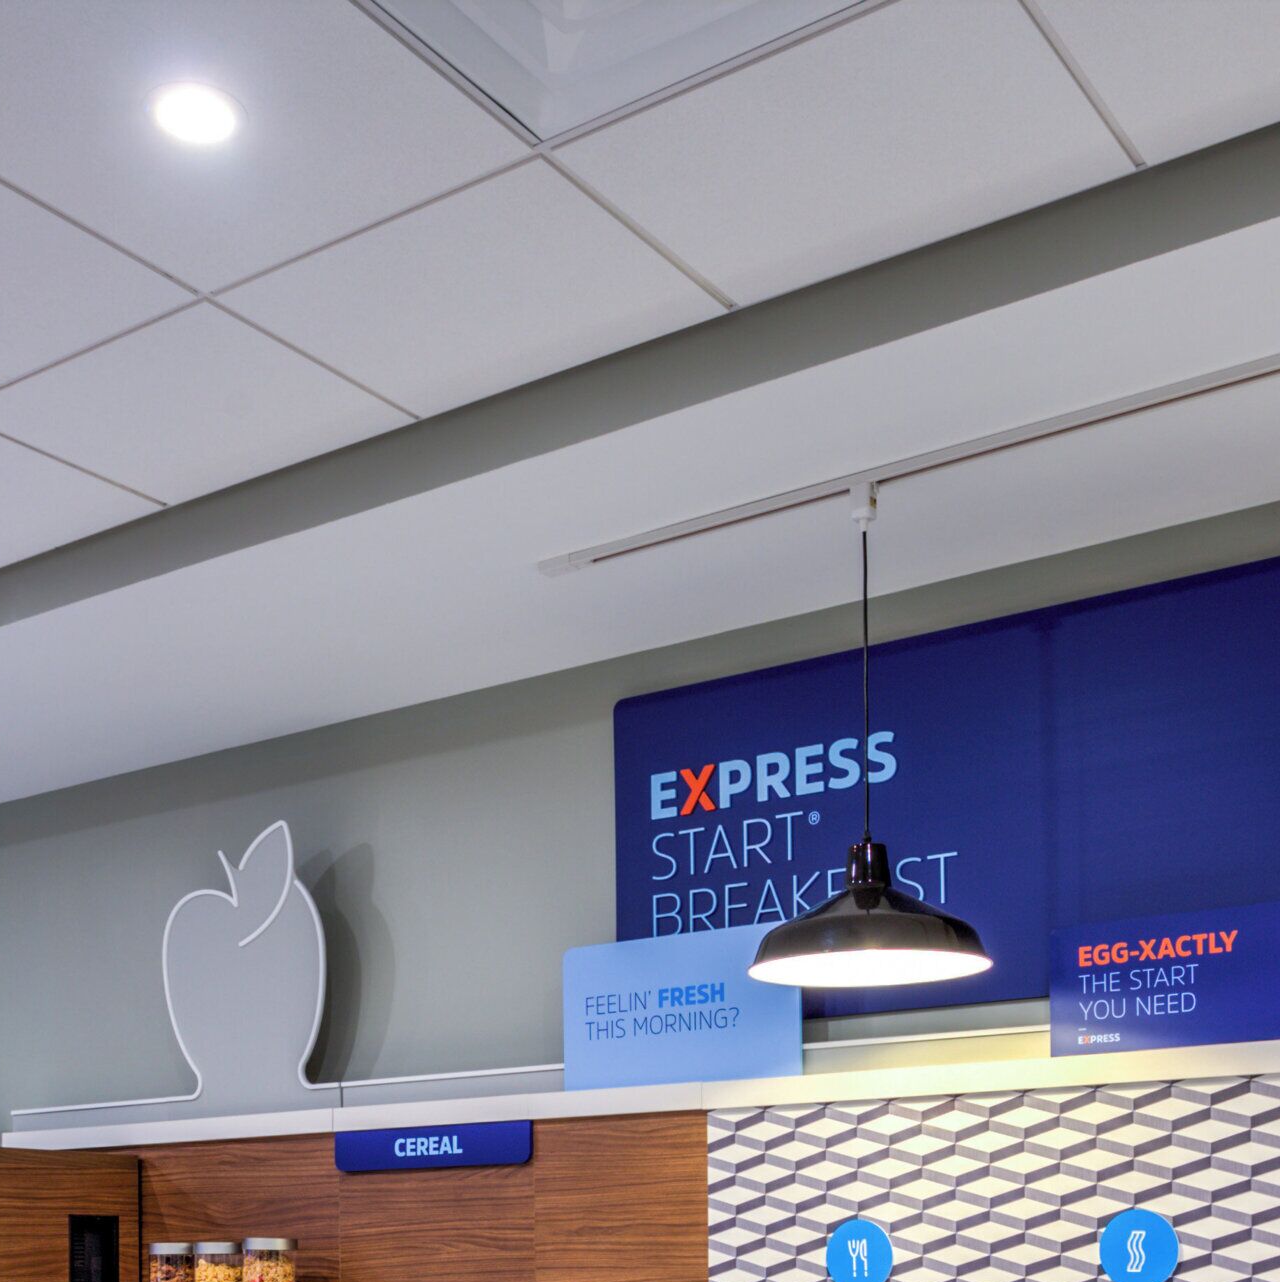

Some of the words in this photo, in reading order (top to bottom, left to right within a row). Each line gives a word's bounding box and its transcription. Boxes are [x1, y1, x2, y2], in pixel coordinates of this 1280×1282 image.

[651, 731, 898, 820] EXPRESS
[1078, 930, 1238, 967] EGG-XACTLY
[1078, 971, 1121, 995] THE
[1129, 964, 1199, 991] START
[658, 982, 725, 1009] FRESH
[1078, 998, 1126, 1021] YOU
[1136, 992, 1197, 1016] NEED
[585, 1018, 626, 1040] THIS
[634, 1007, 740, 1037] MORNING?
[1078, 1033, 1121, 1045] EXPRESS
[394, 1135, 463, 1157] CEREAL
